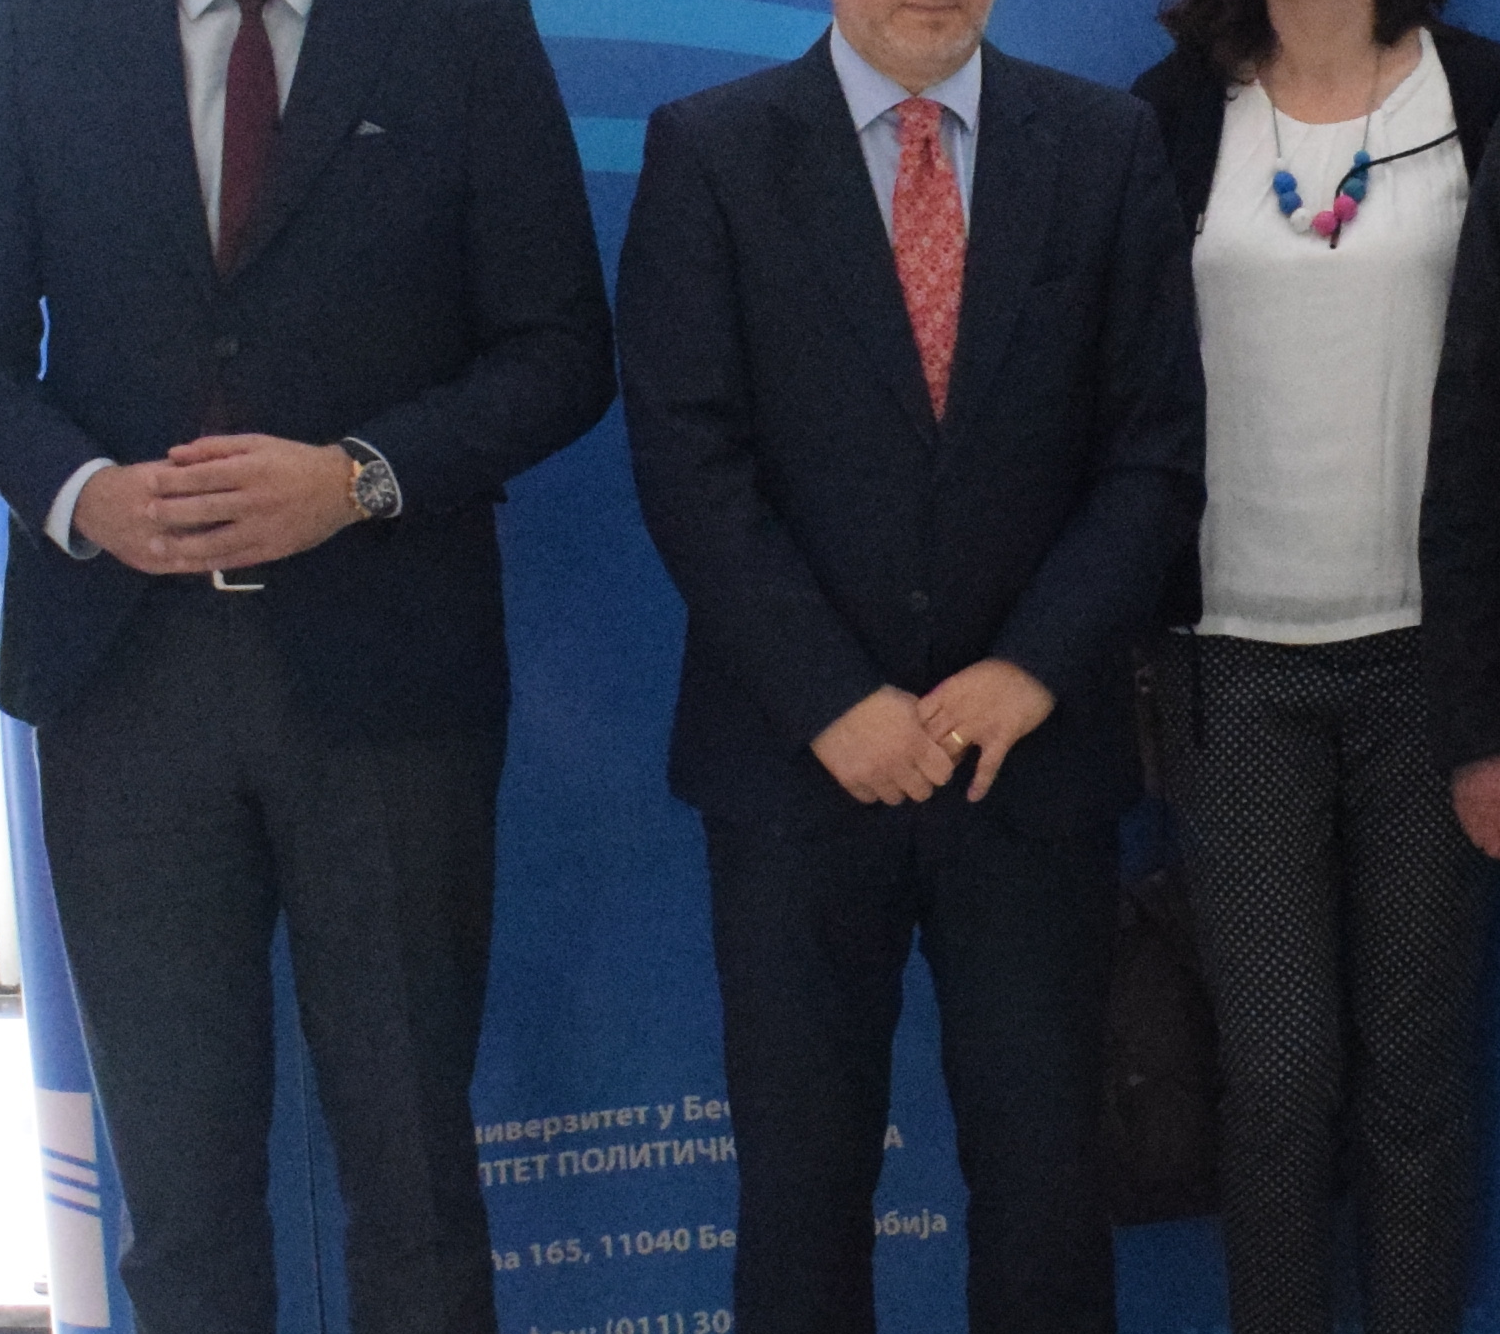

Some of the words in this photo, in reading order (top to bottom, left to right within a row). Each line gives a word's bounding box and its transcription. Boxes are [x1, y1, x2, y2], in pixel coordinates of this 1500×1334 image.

[475, 1106, 650, 1145] иверзитет
[657, 1103, 675, 1131] у
[557, 1135, 738, 1177] ПОЛИТИЧК
[875, 1208, 948, 1240] бија
[530, 1237, 591, 1266] 165,
[601, 1226, 691, 1260] 11040
